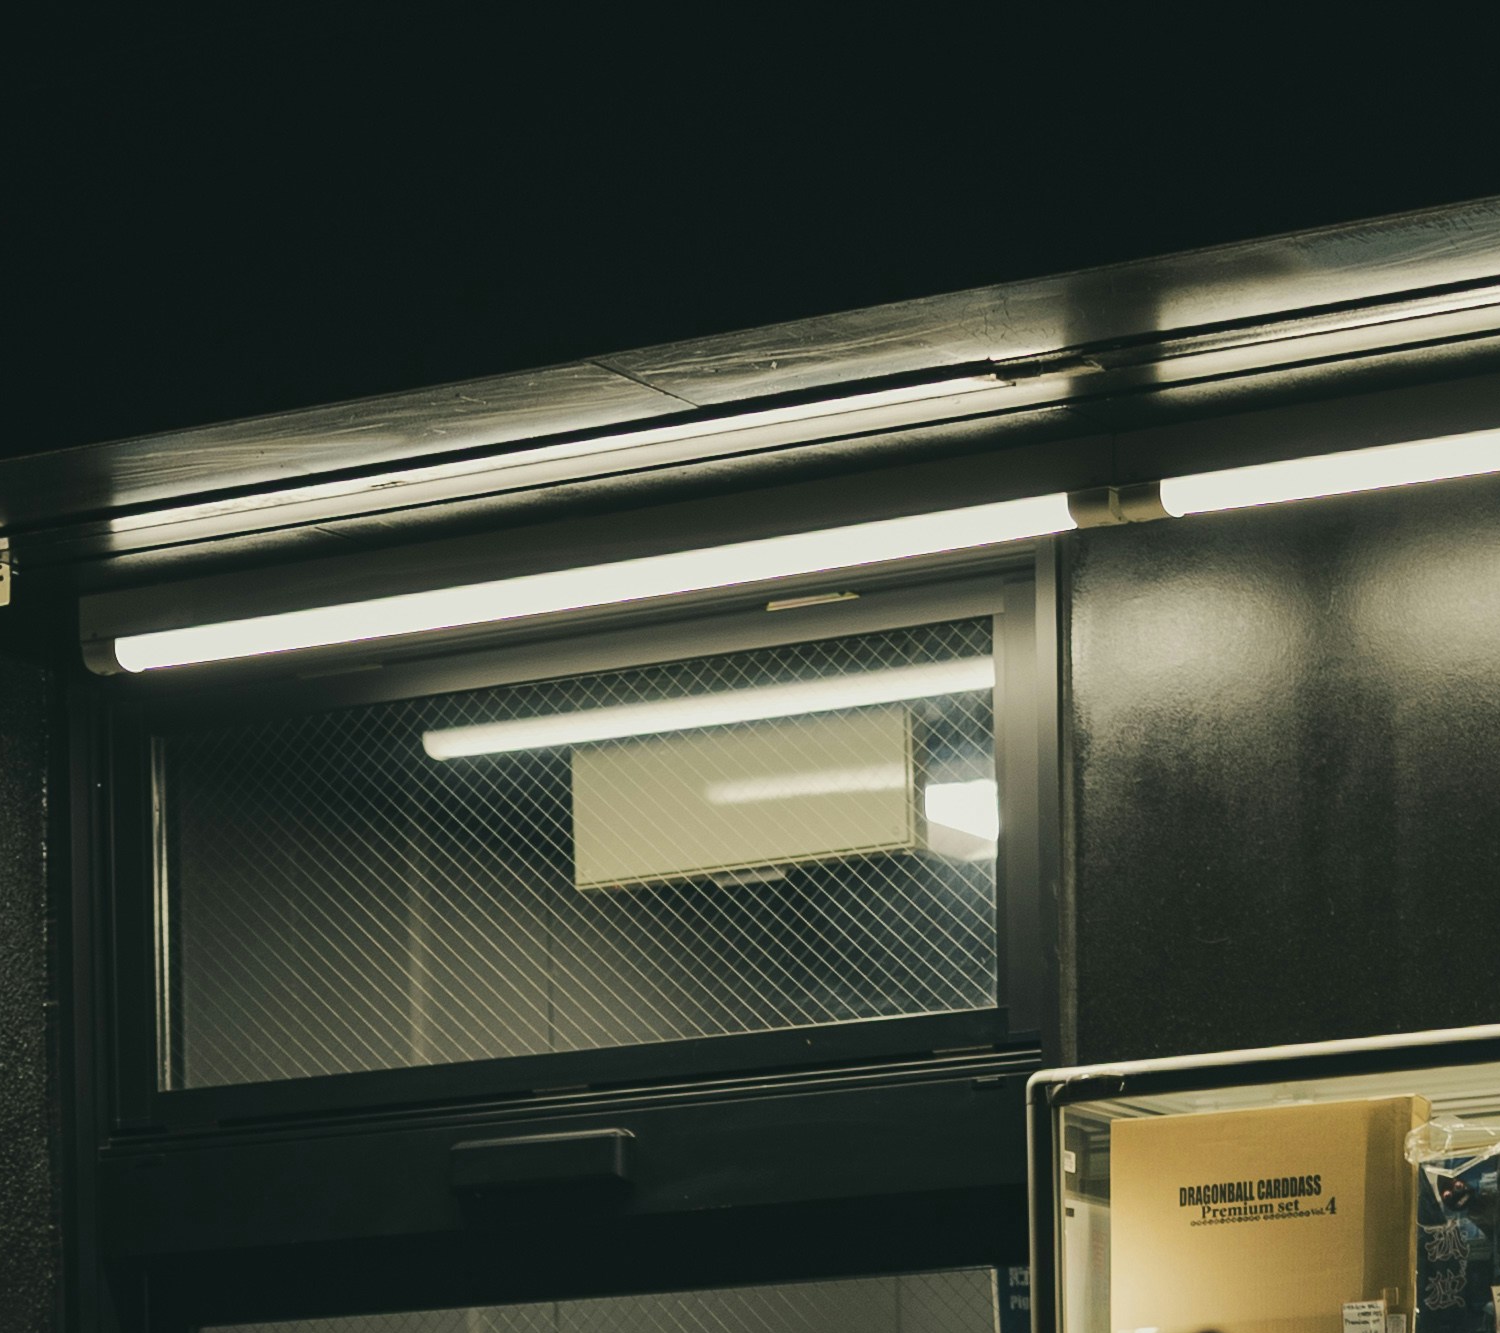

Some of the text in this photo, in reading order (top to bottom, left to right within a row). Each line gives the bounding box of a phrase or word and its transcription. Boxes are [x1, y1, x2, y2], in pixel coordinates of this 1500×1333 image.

[1179, 1174, 1322, 1207] DRAGONBALL CARDDASS
[1201, 1201, 1274, 1219] Premium
[1277, 1199, 1300, 1212] set
